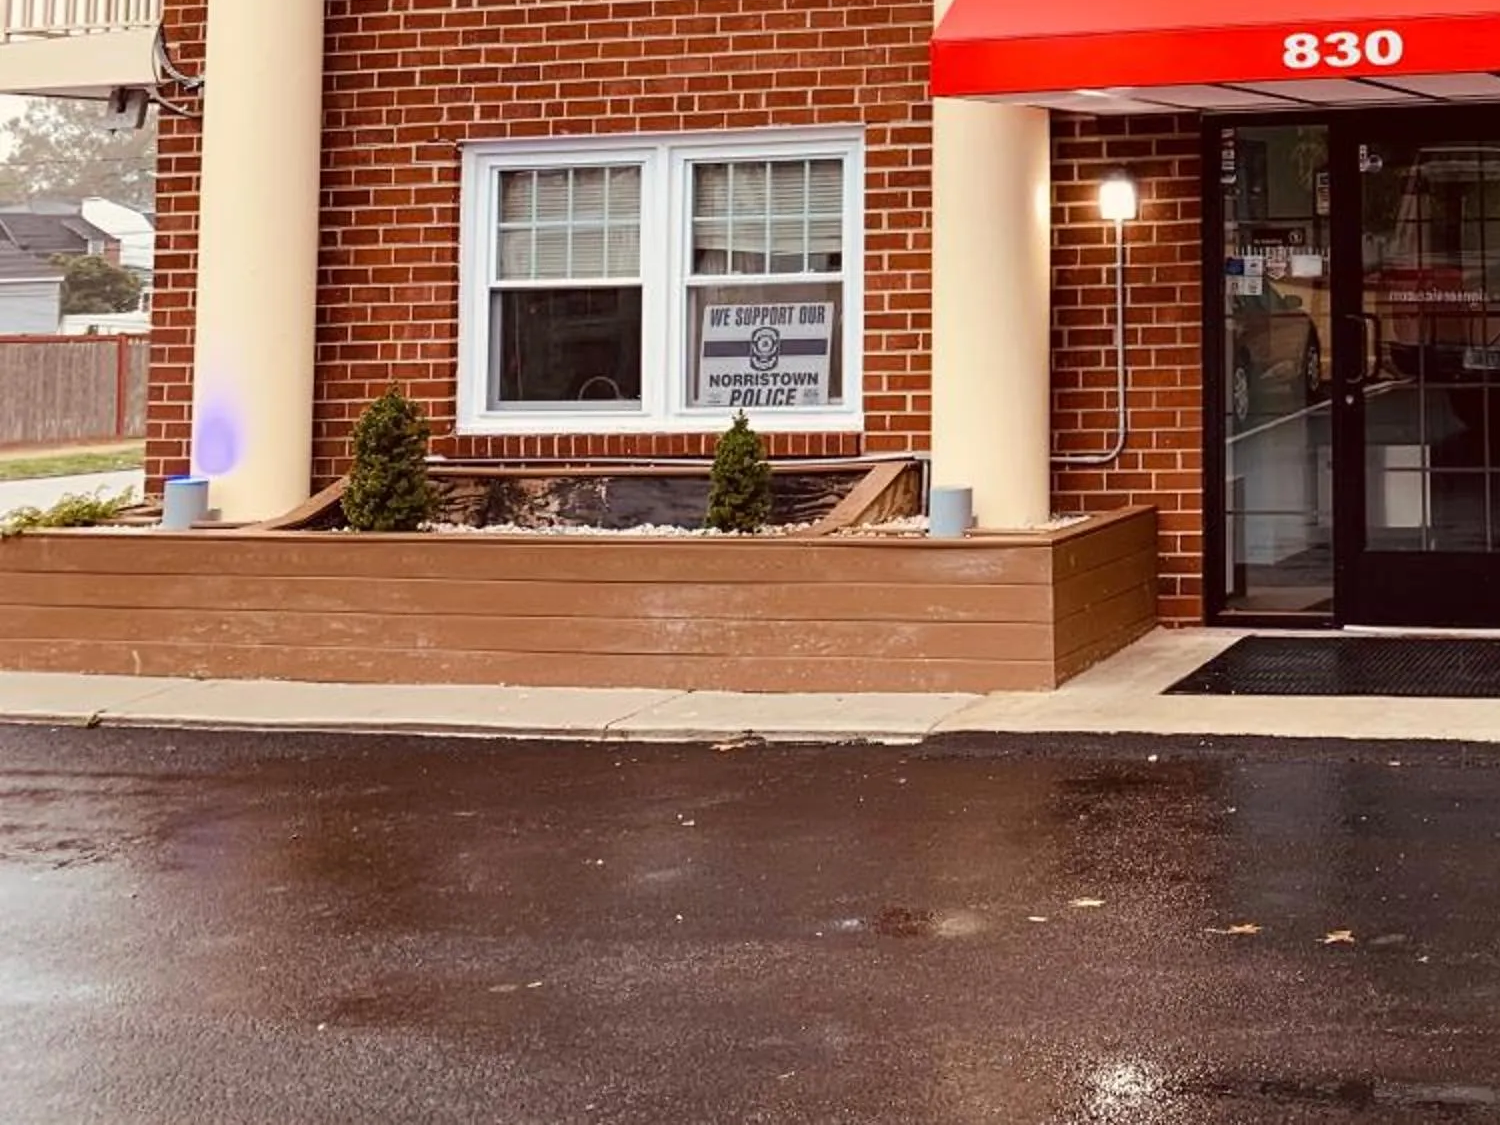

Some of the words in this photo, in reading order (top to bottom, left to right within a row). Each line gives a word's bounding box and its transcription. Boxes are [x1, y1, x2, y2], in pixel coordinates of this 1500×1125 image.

[1282, 29, 1404, 68] 830
[711, 307, 730, 327] WE
[735, 306, 795, 326] SUPPORT
[799, 304, 826, 325] OUR
[709, 372, 819, 387] NORRISTOWN
[729, 388, 797, 407] POLICE
